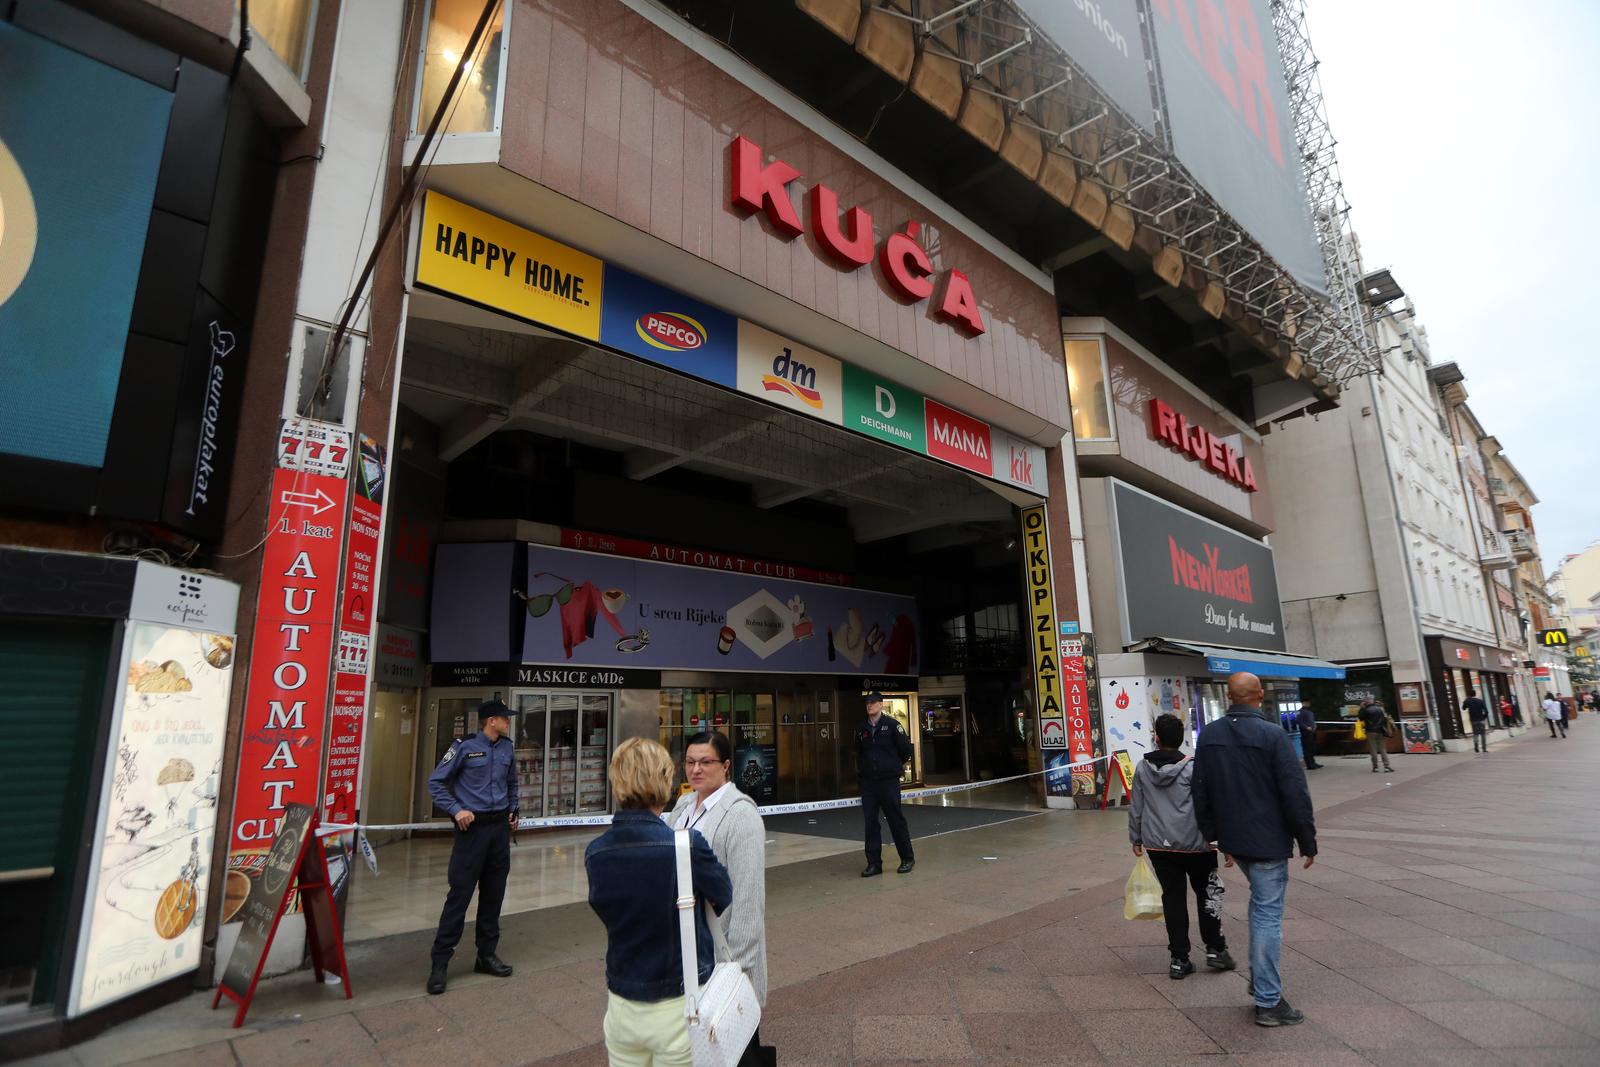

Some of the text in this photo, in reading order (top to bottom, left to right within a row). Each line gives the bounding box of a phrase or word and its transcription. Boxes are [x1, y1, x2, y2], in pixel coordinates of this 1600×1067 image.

[731, 136, 986, 337] KUĆA
[435, 223, 589, 306] HAPPY HOME.
[647, 317, 697, 345] PEPCO
[773, 348, 817, 390] dm
[875, 385, 896, 419] D
[195, 365, 224, 504] europlakat
[860, 415, 912, 441] DEICHMANN
[933, 416, 989, 460] MANA
[1149, 398, 1258, 492] RIJEKA
[302, 520, 333, 538] kat
[352, 521, 379, 539] NON STOP
[650, 545, 746, 571] AUTOMAT
[753, 561, 796, 579] CLUB
[639, 603, 725, 626] U srcu Rijeke
[1026, 512, 1060, 713] OTKUP ZLATA
[260, 551, 318, 810] AUTOMAT
[453, 667, 489, 675] MASKICE
[460, 675, 481, 684] eMDe
[517, 669, 625, 685] MASKICE eMDe
[331, 746, 360, 755] ENTRANCE
[337, 735, 355, 744] NIGHT
[1043, 737, 1064, 745] ULAZ
[330, 756, 359, 766] FROM THE
[331, 768, 355, 777] SEA SIDE
[1072, 764, 1093, 772] CLUB
